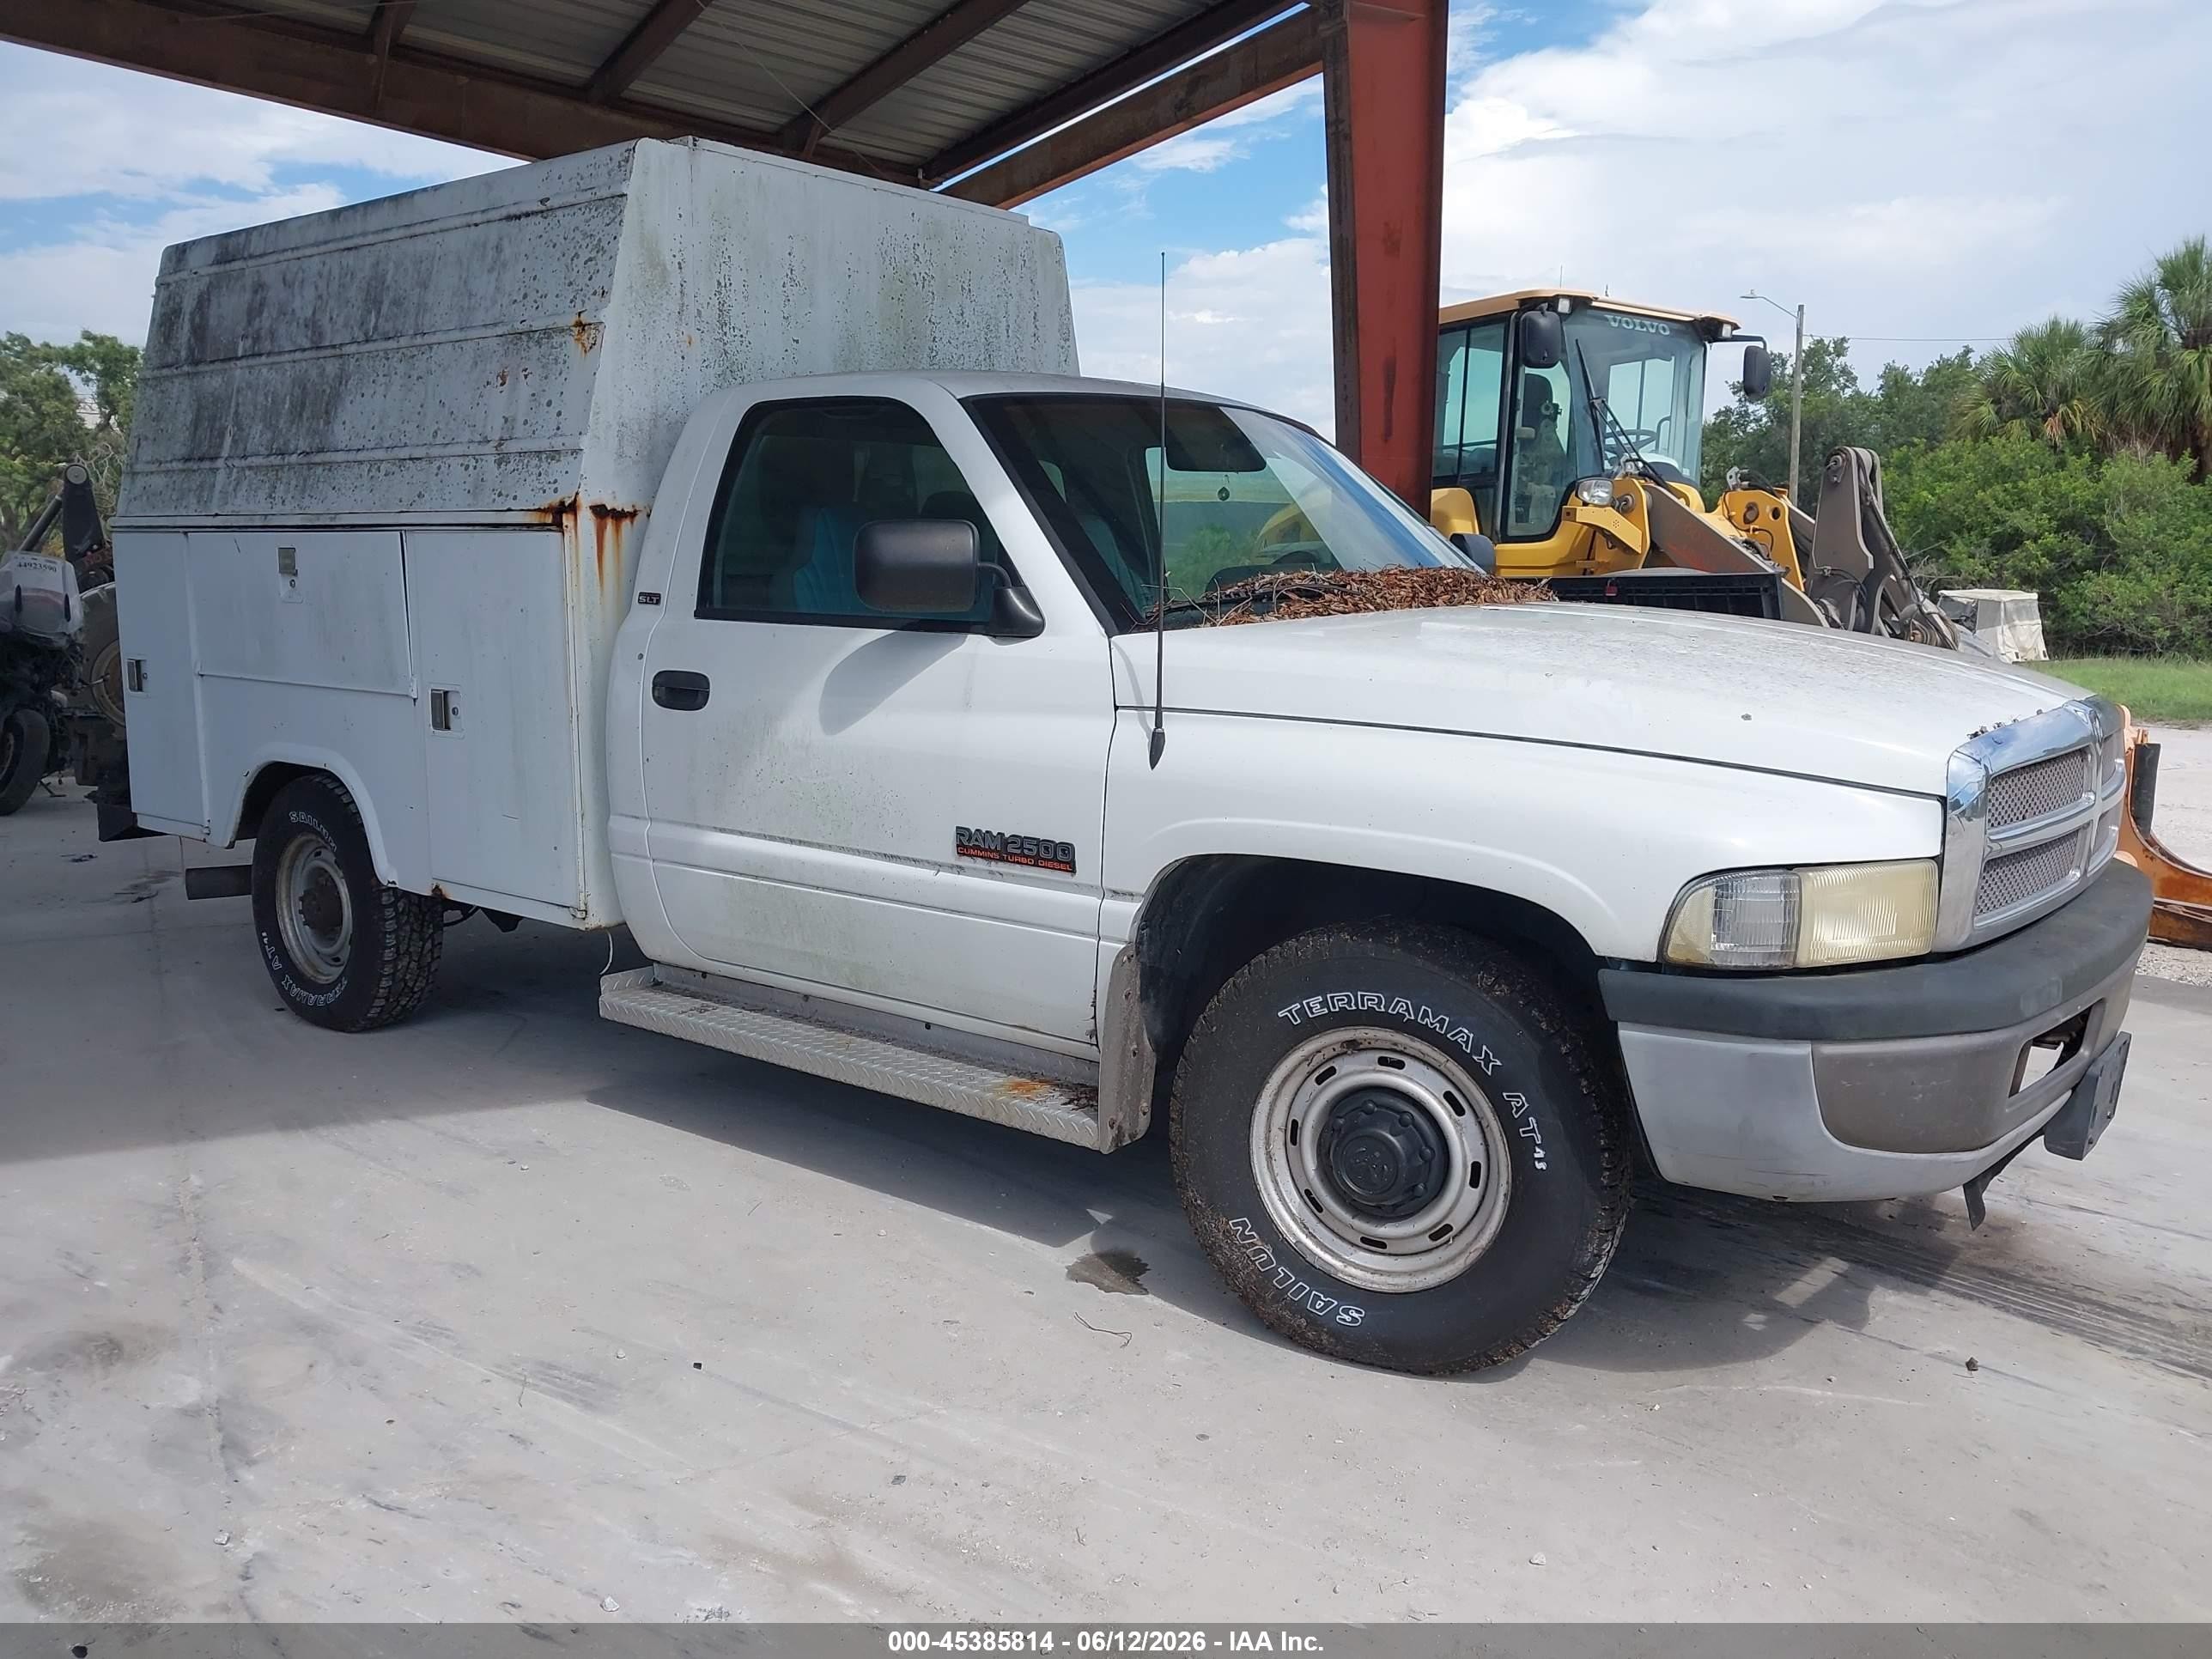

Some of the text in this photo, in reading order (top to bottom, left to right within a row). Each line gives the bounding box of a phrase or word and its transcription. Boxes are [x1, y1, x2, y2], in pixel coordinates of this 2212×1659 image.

[1603, 314, 1670, 336] VOLVO
[956, 827, 1074, 862] RAM 2500
[957, 847, 1073, 872] CUMMINS TURBO DIESEL
[1278, 991, 1502, 1077] TERRAMAX
[1229, 1218, 1365, 1327] SAILUN
